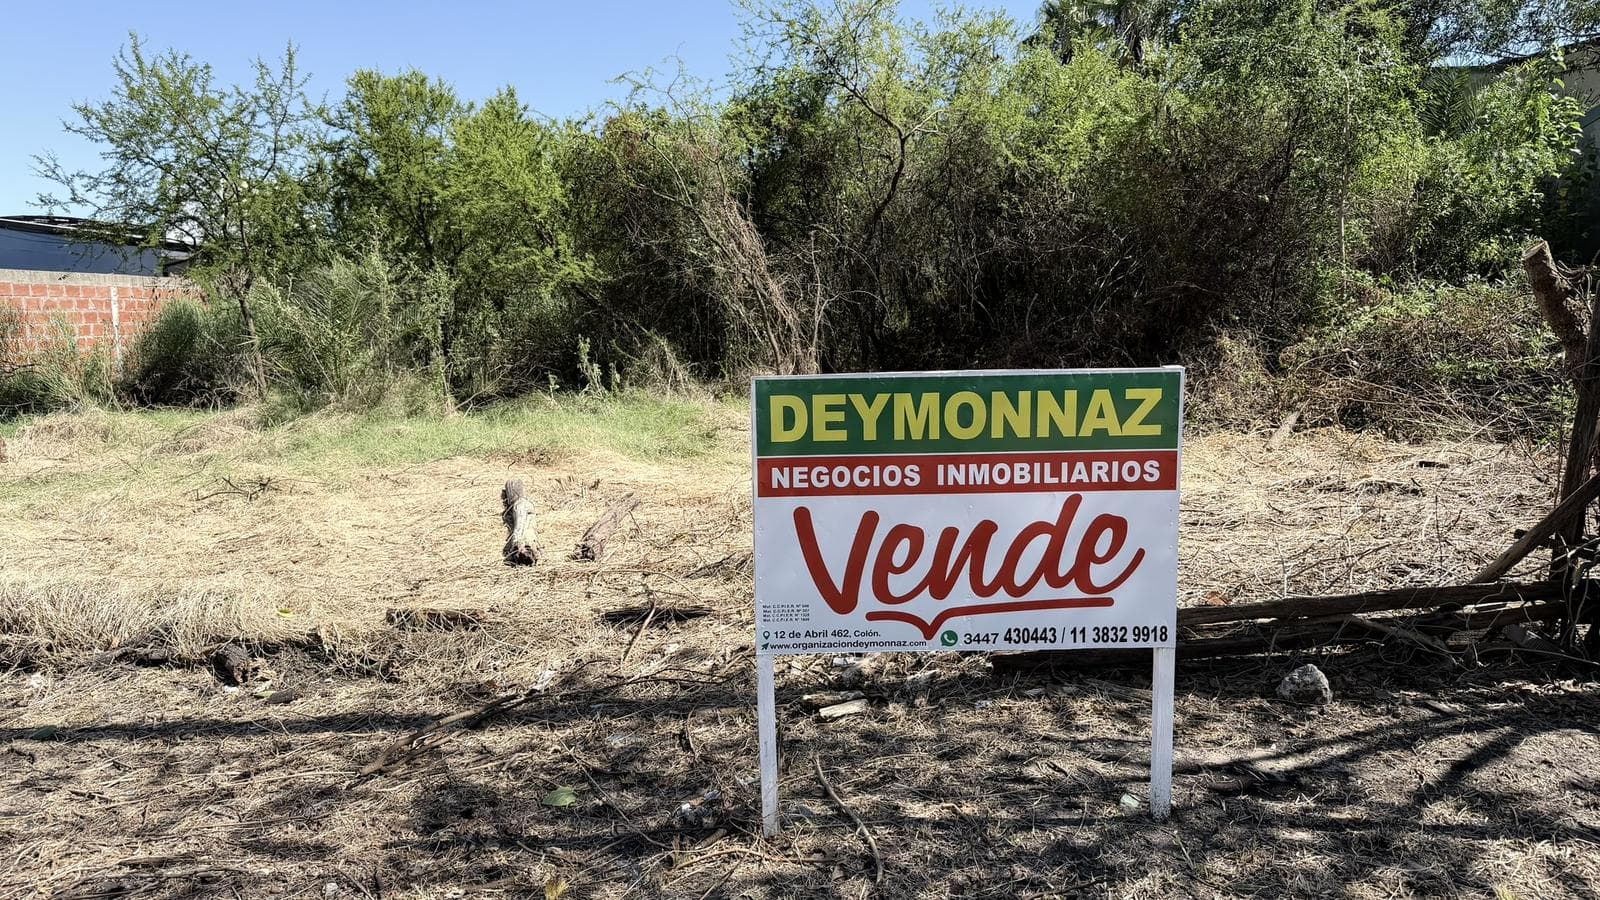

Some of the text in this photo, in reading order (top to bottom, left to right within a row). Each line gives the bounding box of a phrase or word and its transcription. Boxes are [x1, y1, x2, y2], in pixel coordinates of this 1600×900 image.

[769, 387, 1163, 443] DEYMONNAZ
[771, 460, 1160, 489] NEGOCIOS INMOBILIARIOS
[793, 493, 1145, 615] Vende
[770, 639, 927, 650] www.organizaciondeymonnaz.com
[774, 631, 786, 639] 12
[789, 631, 801, 639] de
[804, 630, 828, 638] Abril
[854, 629, 881, 638] Colón.
[963, 625, 1168, 644] 3447 430443 / 11 3832 9918
